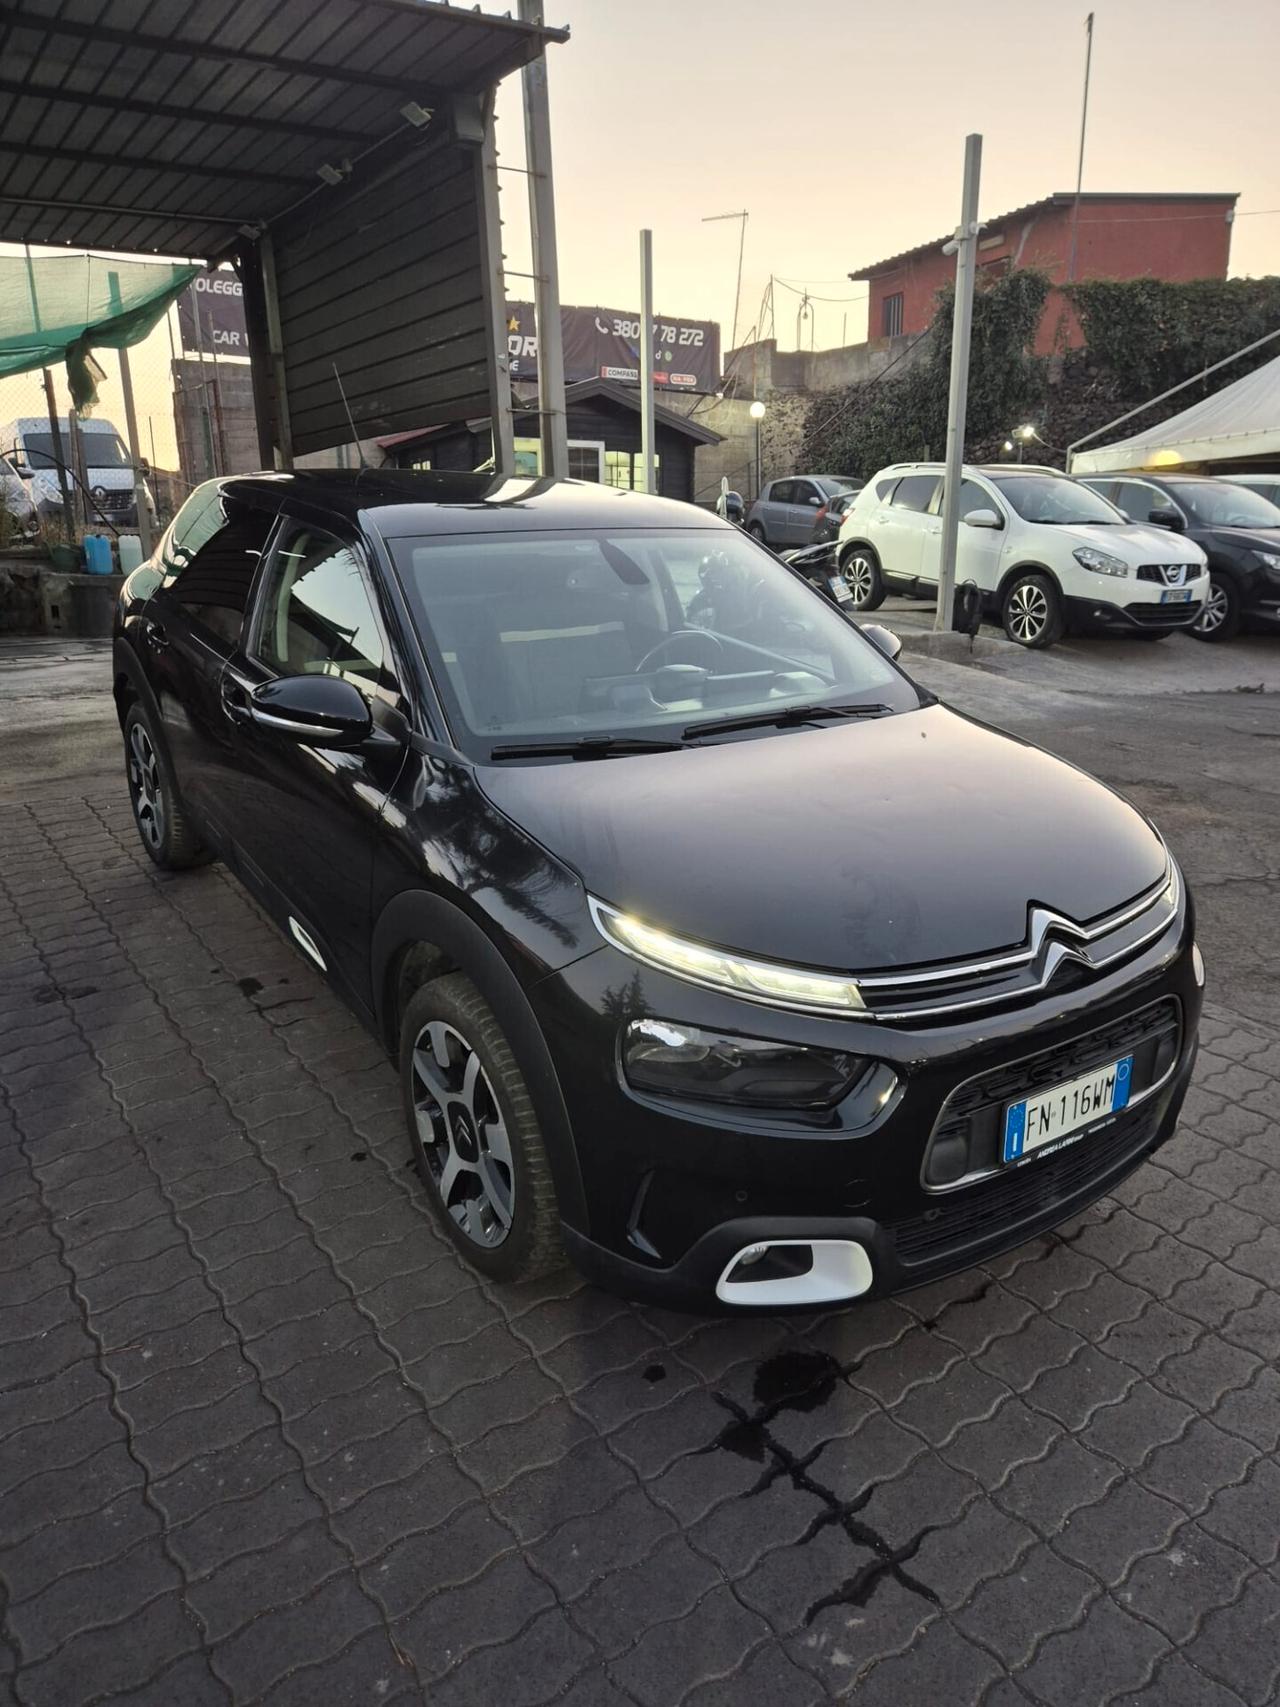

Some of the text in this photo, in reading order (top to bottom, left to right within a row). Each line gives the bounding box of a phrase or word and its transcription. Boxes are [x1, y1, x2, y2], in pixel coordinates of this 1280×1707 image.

[212, 330, 240, 346] CAR
[660, 325, 676, 344] 78
[679, 327, 704, 346] 272
